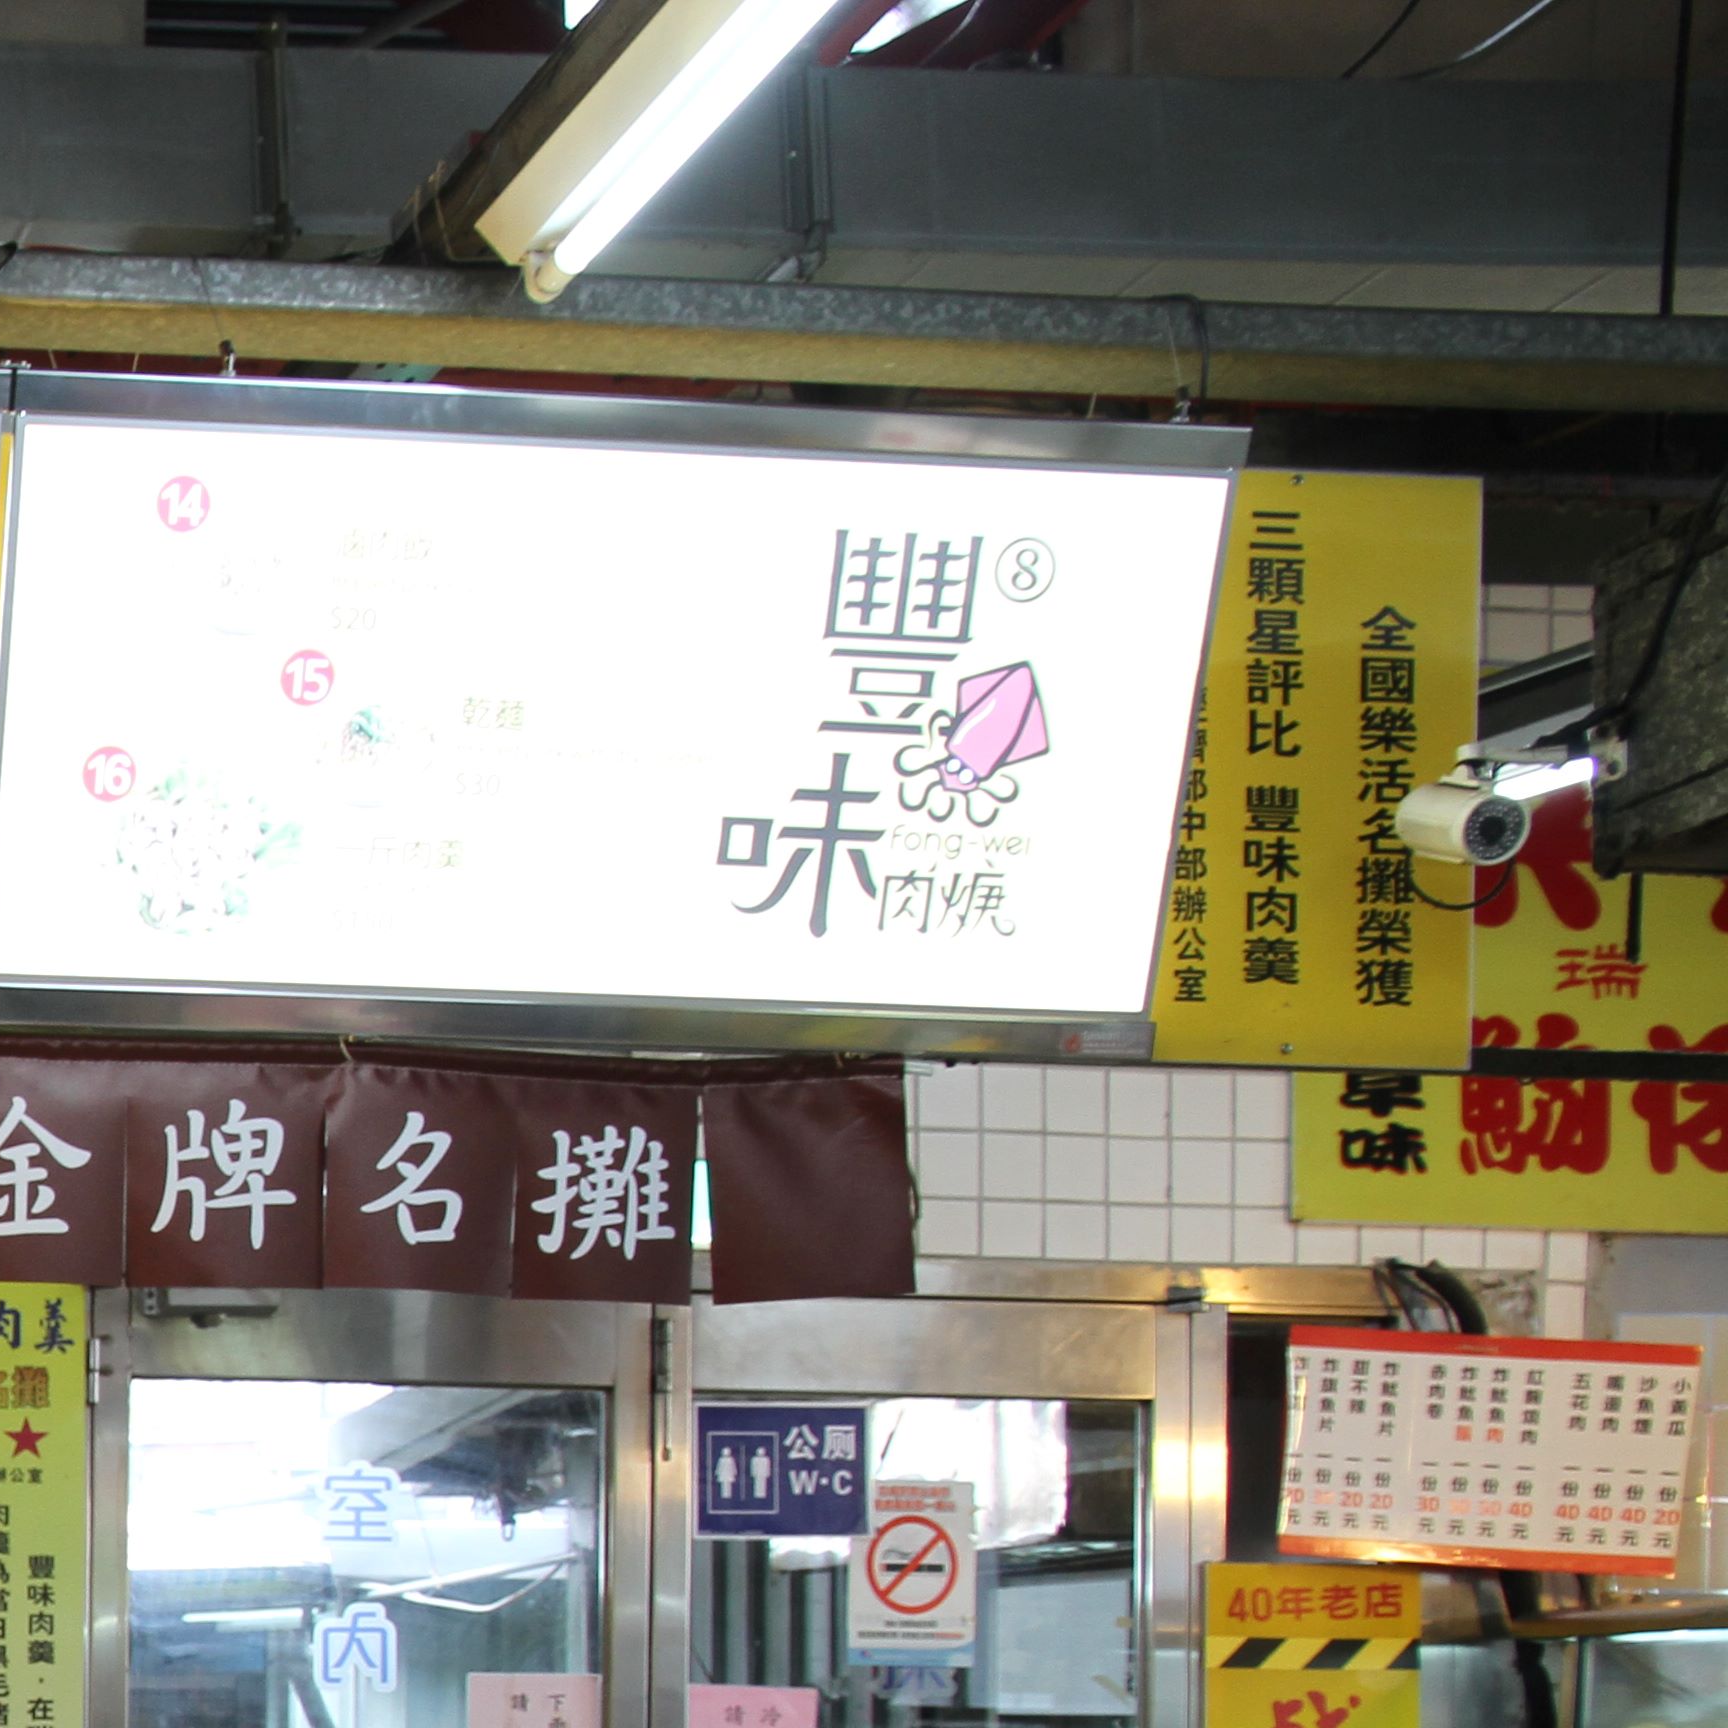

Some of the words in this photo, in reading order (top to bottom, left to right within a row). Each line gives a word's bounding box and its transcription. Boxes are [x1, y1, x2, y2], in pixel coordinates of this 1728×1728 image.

[159, 482, 205, 527] 14
[1245, 510, 1306, 758] 三顆星評比
[285, 660, 331, 701] 15
[86, 754, 134, 797] 16
[1241, 785, 1301, 986] 豐味肉羹
[1226, 1583, 1404, 1623] 40年老店
